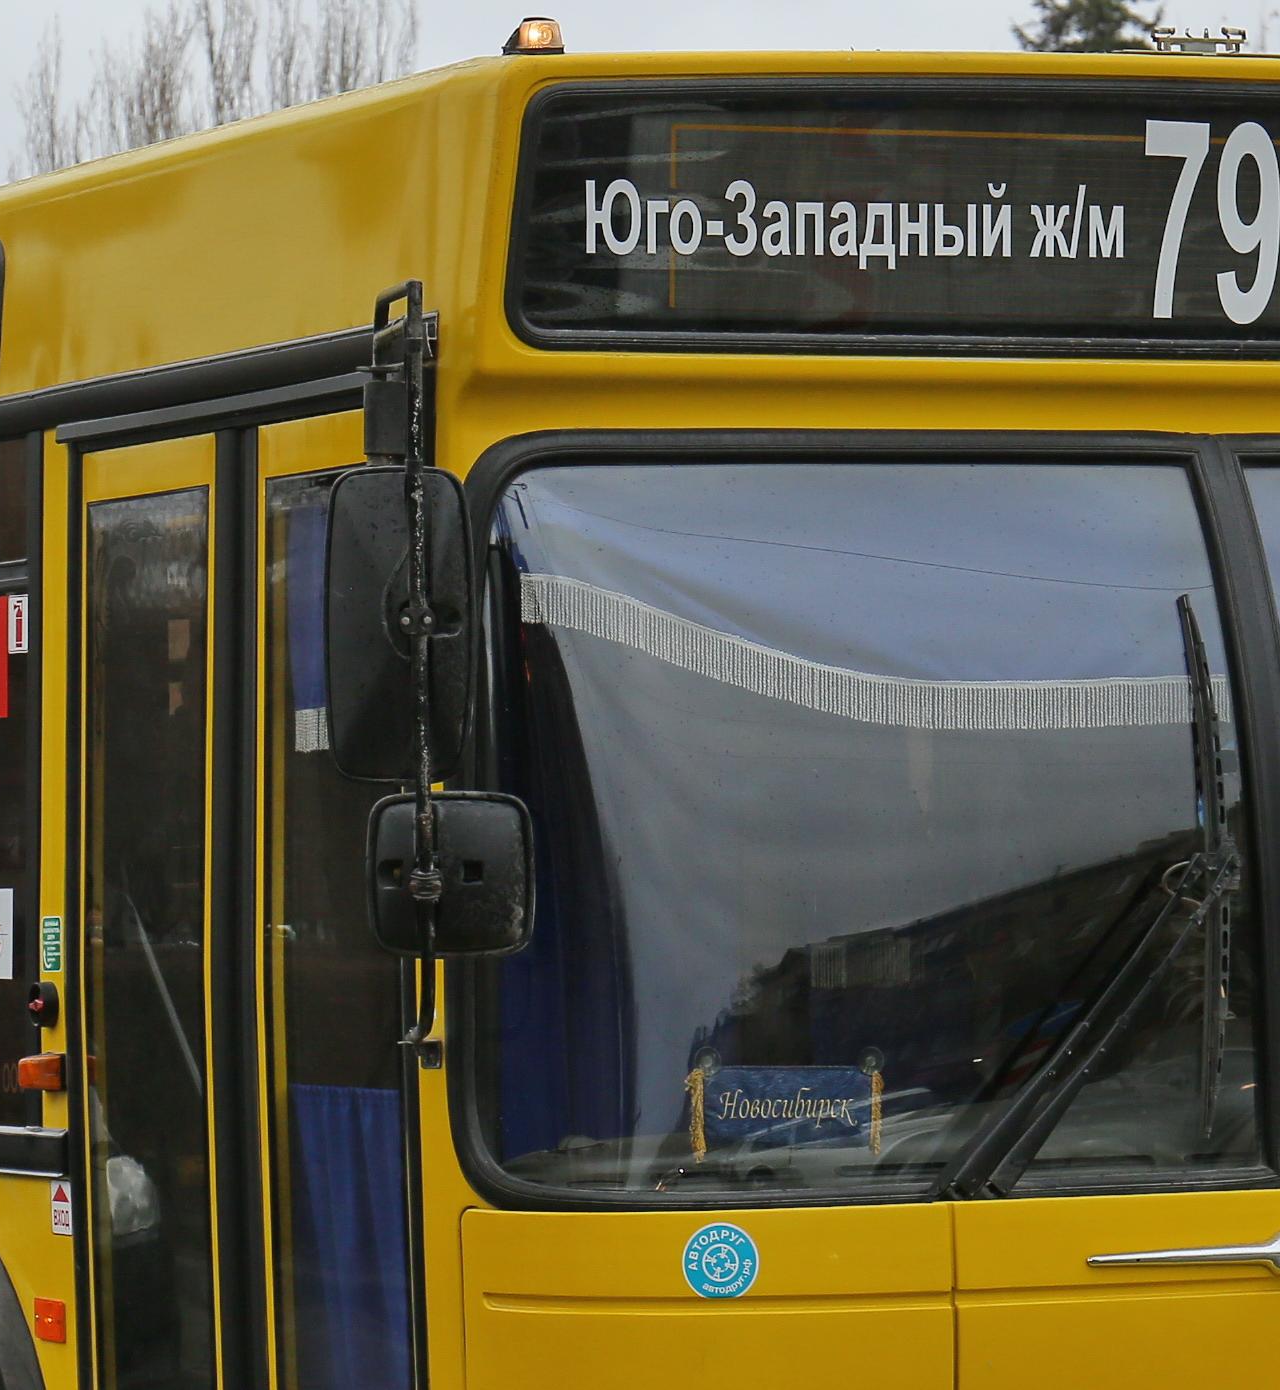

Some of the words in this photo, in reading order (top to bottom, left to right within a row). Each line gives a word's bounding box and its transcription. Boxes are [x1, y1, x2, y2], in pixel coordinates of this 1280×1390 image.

[585, 179, 1012, 270] Юго-Западный
[1030, 184, 1124, 259] ж/м
[1144, 119, 1280, 325] 79
[718, 1087, 858, 1128] Новосибирск
[53, 1209, 70, 1228] ВХОД
[688, 1230, 745, 1270] АВТОДРУГ
[702, 1259, 753, 1294] автодруг.рф
